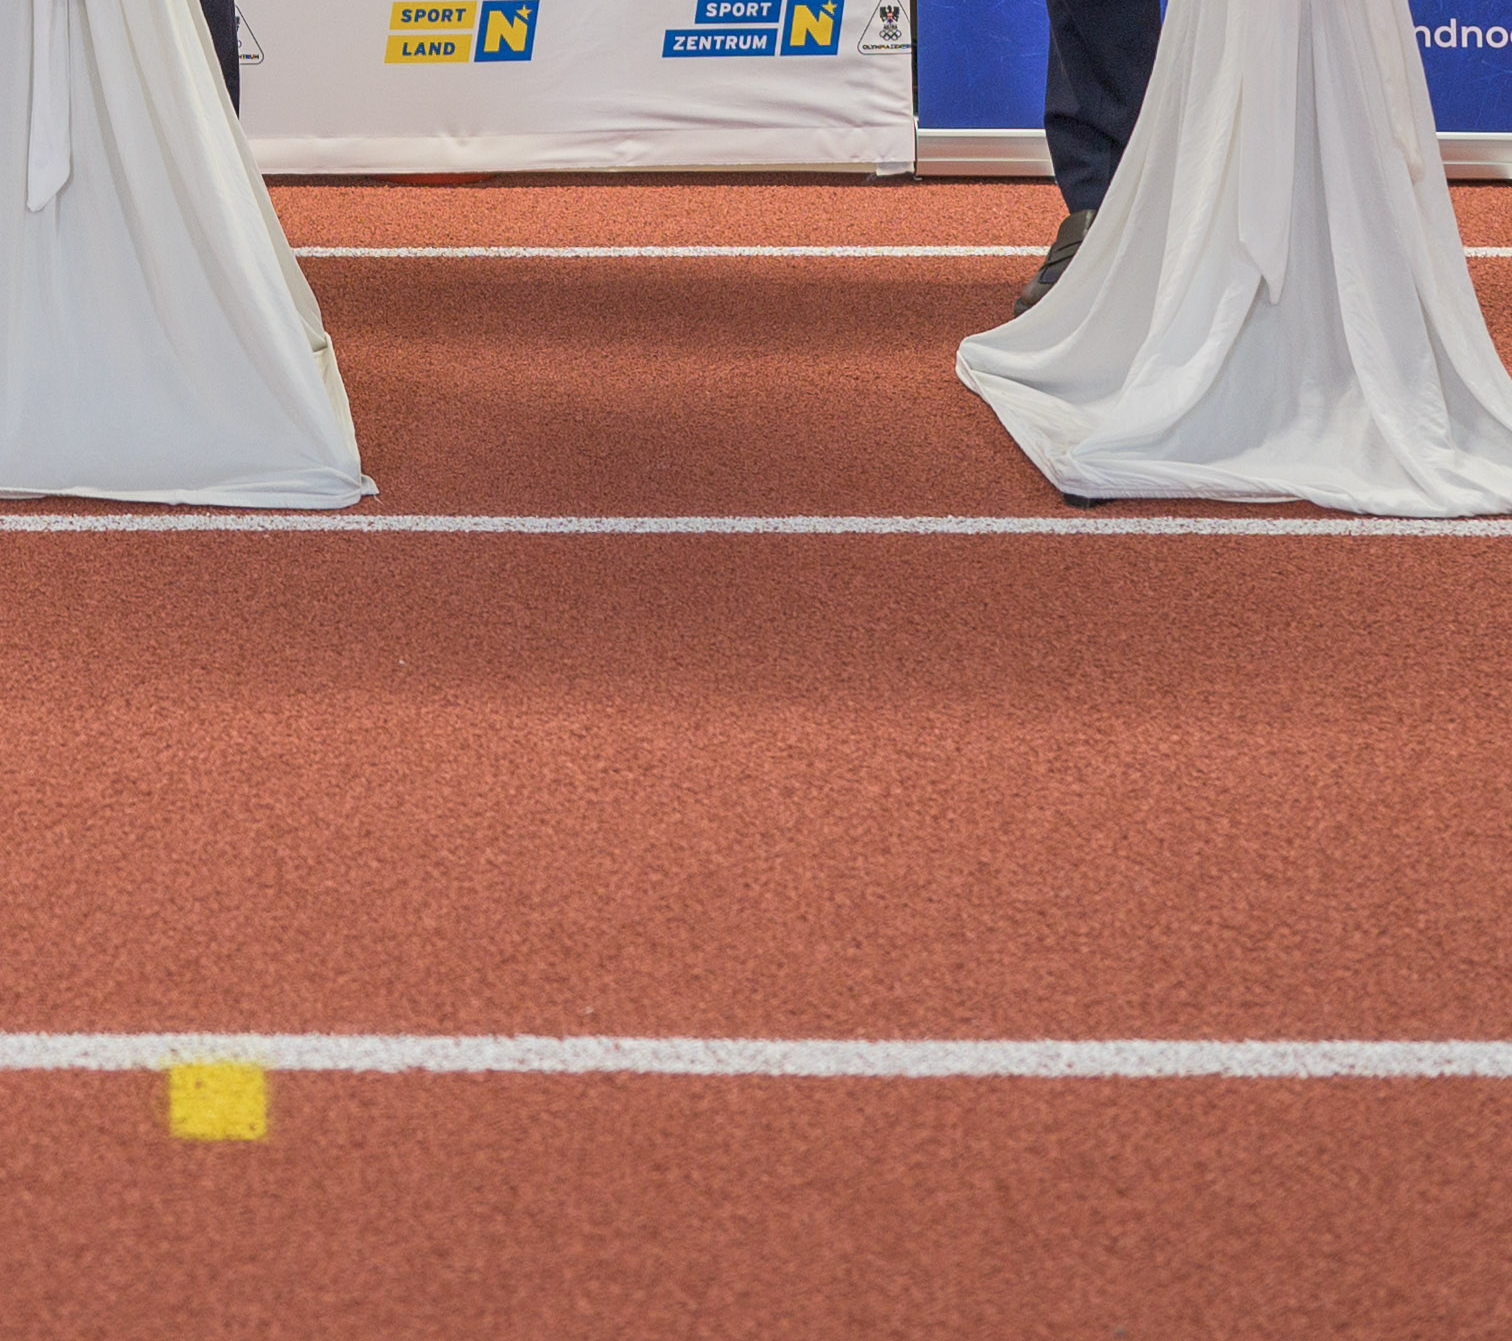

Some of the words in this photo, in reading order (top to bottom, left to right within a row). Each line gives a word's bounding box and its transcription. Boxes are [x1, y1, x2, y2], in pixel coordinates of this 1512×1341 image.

[400, 8, 467, 23] SPORT
[705, 1, 773, 18] SPORT
[402, 41, 456, 57] LAND
[672, 34, 768, 51] ZENTRUM
